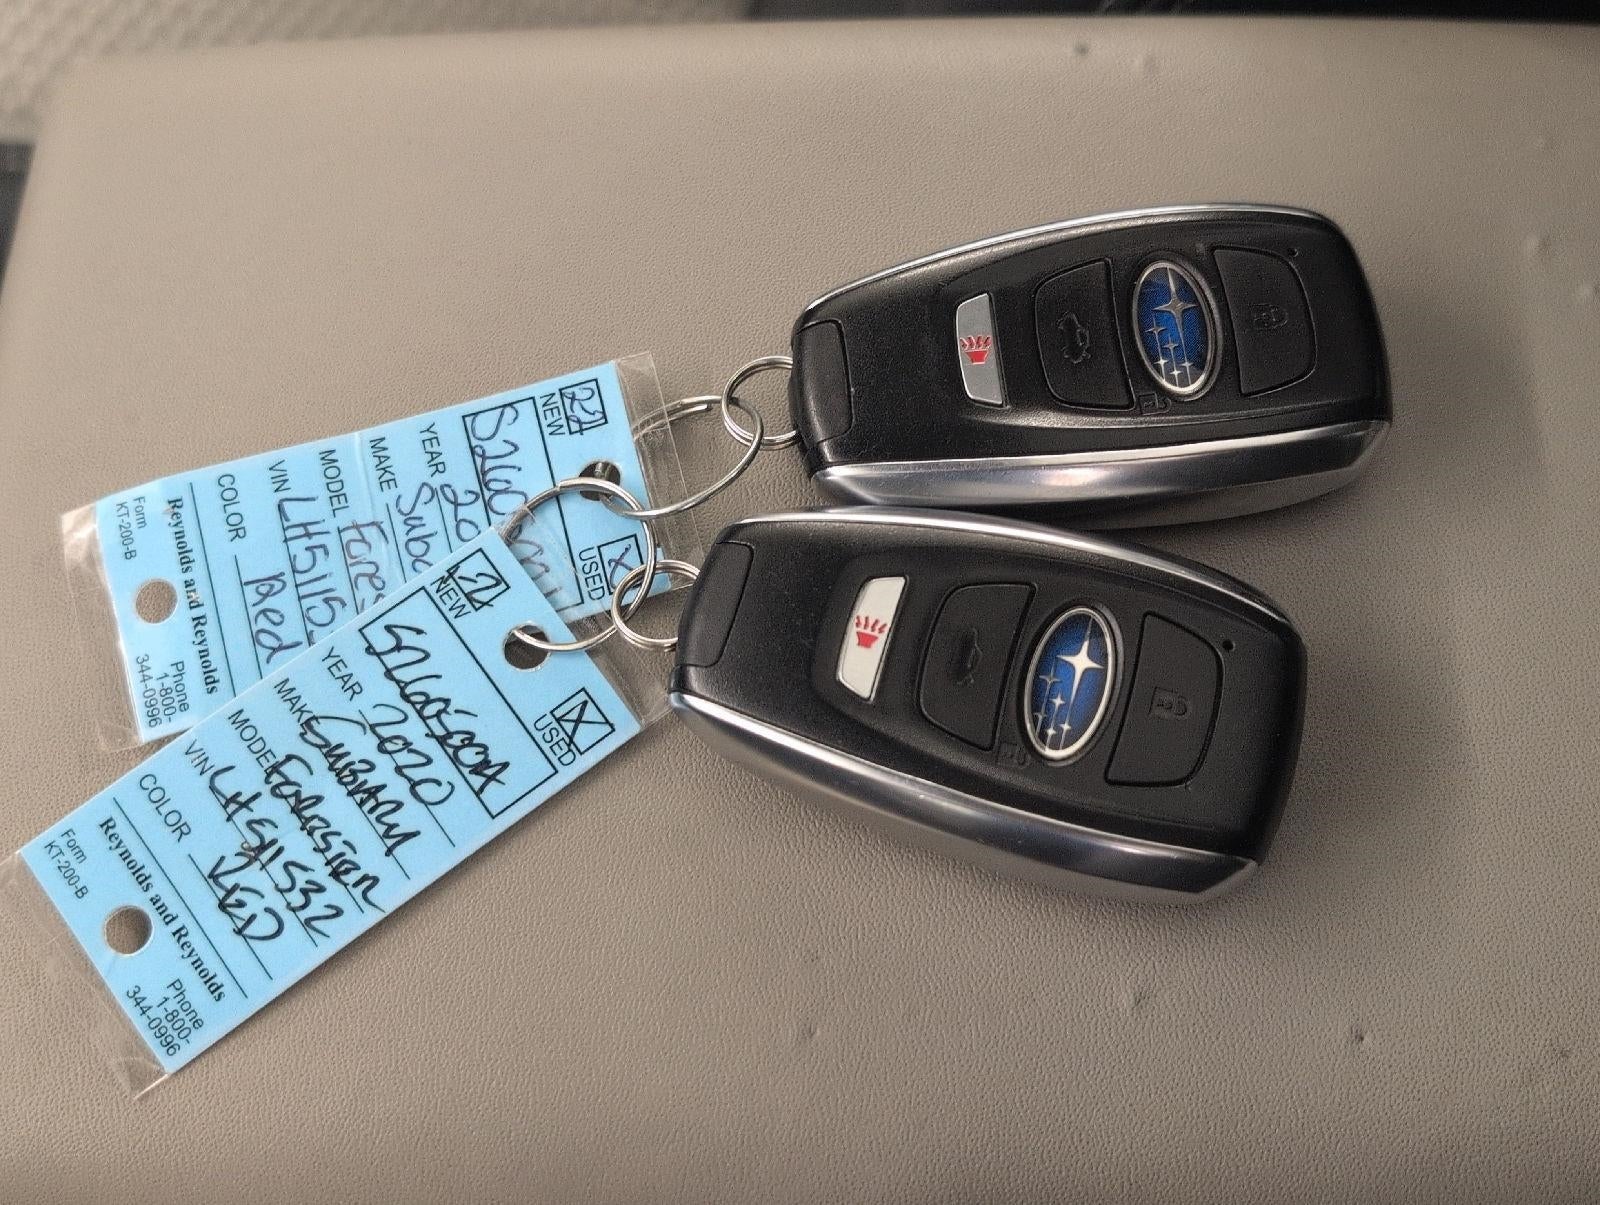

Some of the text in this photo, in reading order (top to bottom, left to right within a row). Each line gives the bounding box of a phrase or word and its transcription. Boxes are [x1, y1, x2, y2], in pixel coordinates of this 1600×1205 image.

[540, 392, 566, 436] NEW
[269, 459, 291, 493] VIN
[369, 437, 398, 493] MAKE
[419, 422, 446, 478] YEAR
[217, 473, 247, 542] COLOR
[319, 449, 350, 518] MODEL
[115, 501, 137, 561] KT-200-B
[132, 496, 147, 529] Form
[440, 483, 481, 542] 20
[167, 496, 219, 695] Reynolds and Reynolds
[277, 496, 347, 647] LH5115
[430, 574, 472, 620] NEW
[578, 547, 606, 601] USED
[243, 571, 303, 664] Red
[136, 654, 162, 728] 344-0996
[155, 672, 172, 724] 1-800-
[170, 660, 190, 713] Phone
[274, 678, 320, 725] MAKE
[321, 646, 363, 701] YEAR
[184, 739, 215, 777] VIN
[370, 703, 455, 805] 2020
[534, 714, 577, 769] USED
[139, 773, 192, 843] COLOR
[44, 840, 89, 899] KT-200-B
[61, 828, 88, 864] Form
[99, 816, 226, 1003] Reynolds and Reynolds
[126, 985, 181, 1057] 344-0996
[156, 996, 192, 1046] 1-800-
[166, 978, 205, 1030] Phone
